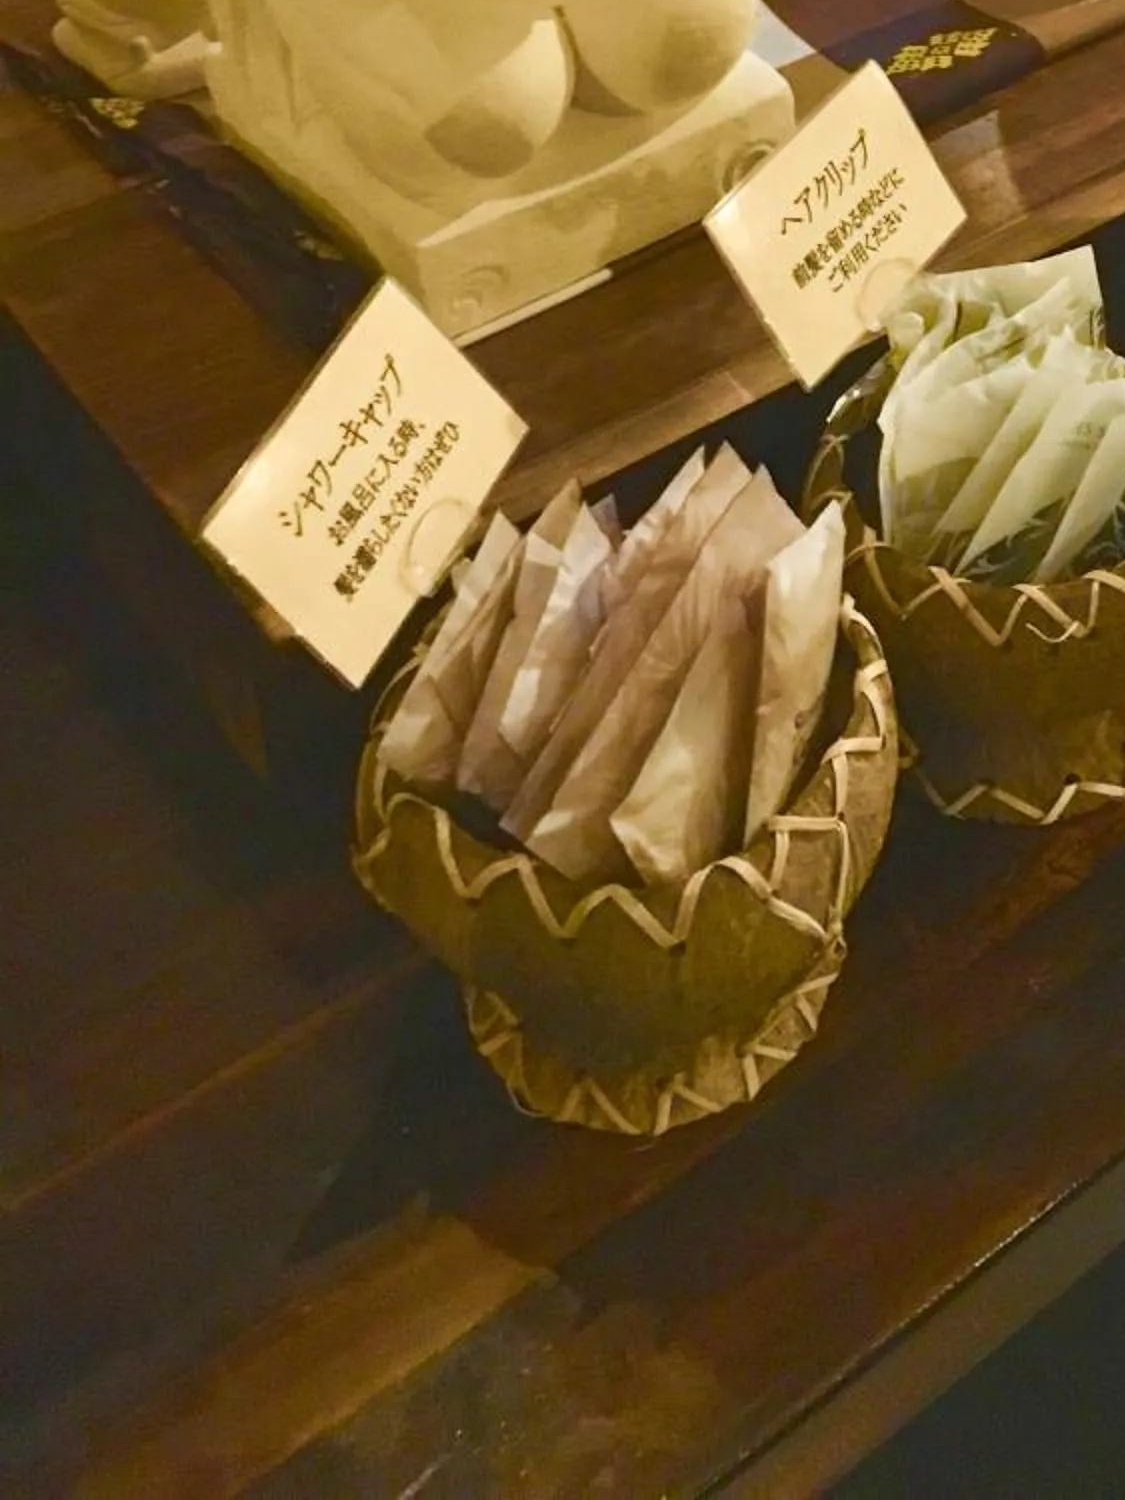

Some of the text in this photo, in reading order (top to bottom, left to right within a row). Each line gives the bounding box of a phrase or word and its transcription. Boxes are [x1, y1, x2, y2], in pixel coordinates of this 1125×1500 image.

[780, 128, 871, 237] ヘアクリップ
[827, 203, 909, 294] ご利用ください
[276, 353, 402, 538] シャワーキャップ
